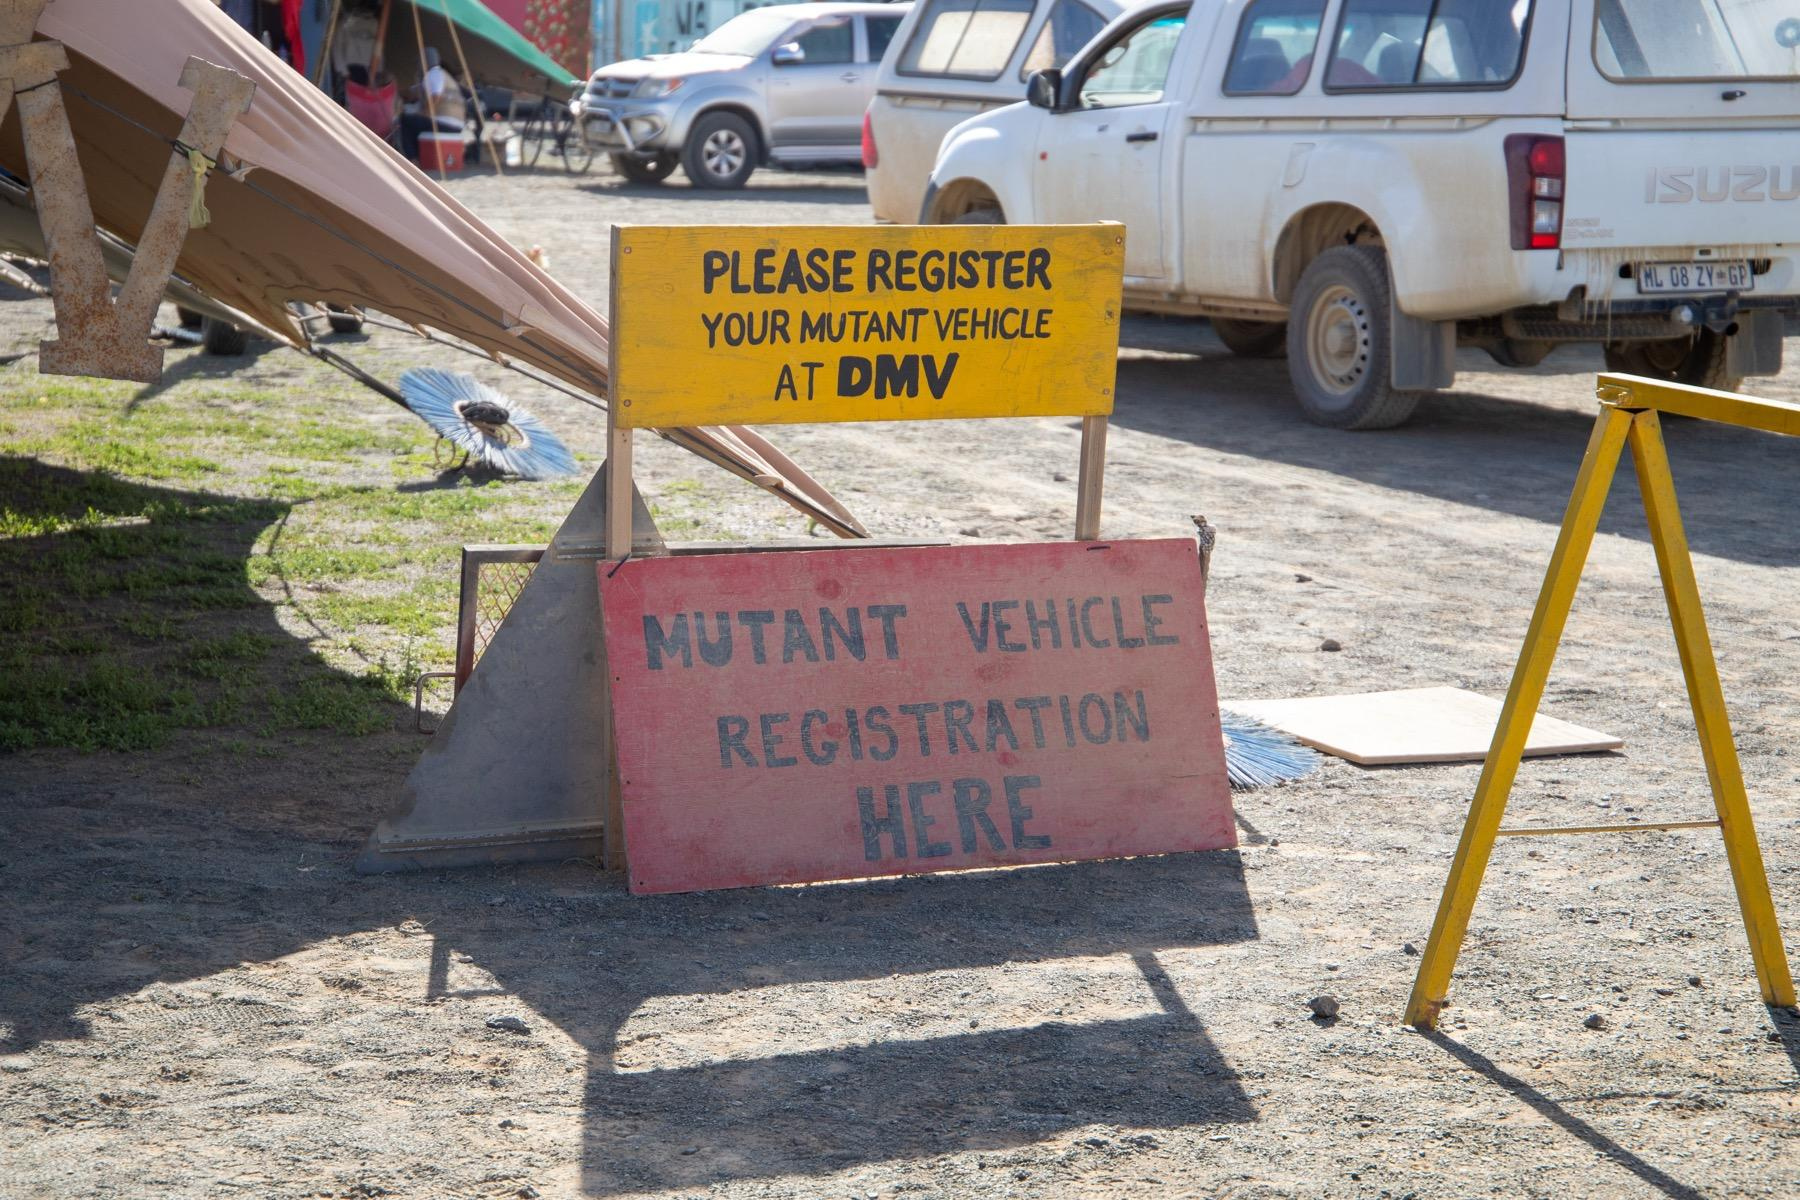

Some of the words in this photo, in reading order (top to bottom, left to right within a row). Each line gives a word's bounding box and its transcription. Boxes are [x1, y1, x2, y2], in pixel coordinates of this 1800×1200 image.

[1645, 165, 1800, 203] ISUZU
[703, 248, 856, 294] PLEASE
[867, 247, 1052, 293] REGISTER
[1670, 265, 1689, 287] 08
[701, 309, 791, 348] YOUR
[799, 307, 929, 344] MUTANT
[933, 307, 1053, 341] VEHICLE
[774, 361, 824, 401] AT
[837, 352, 960, 400] DMV
[642, 604, 907, 670] MUTANT
[956, 594, 1181, 653] VEHICLE
[716, 689, 1151, 769] REGISTRATION
[856, 774, 1053, 861] HERE
